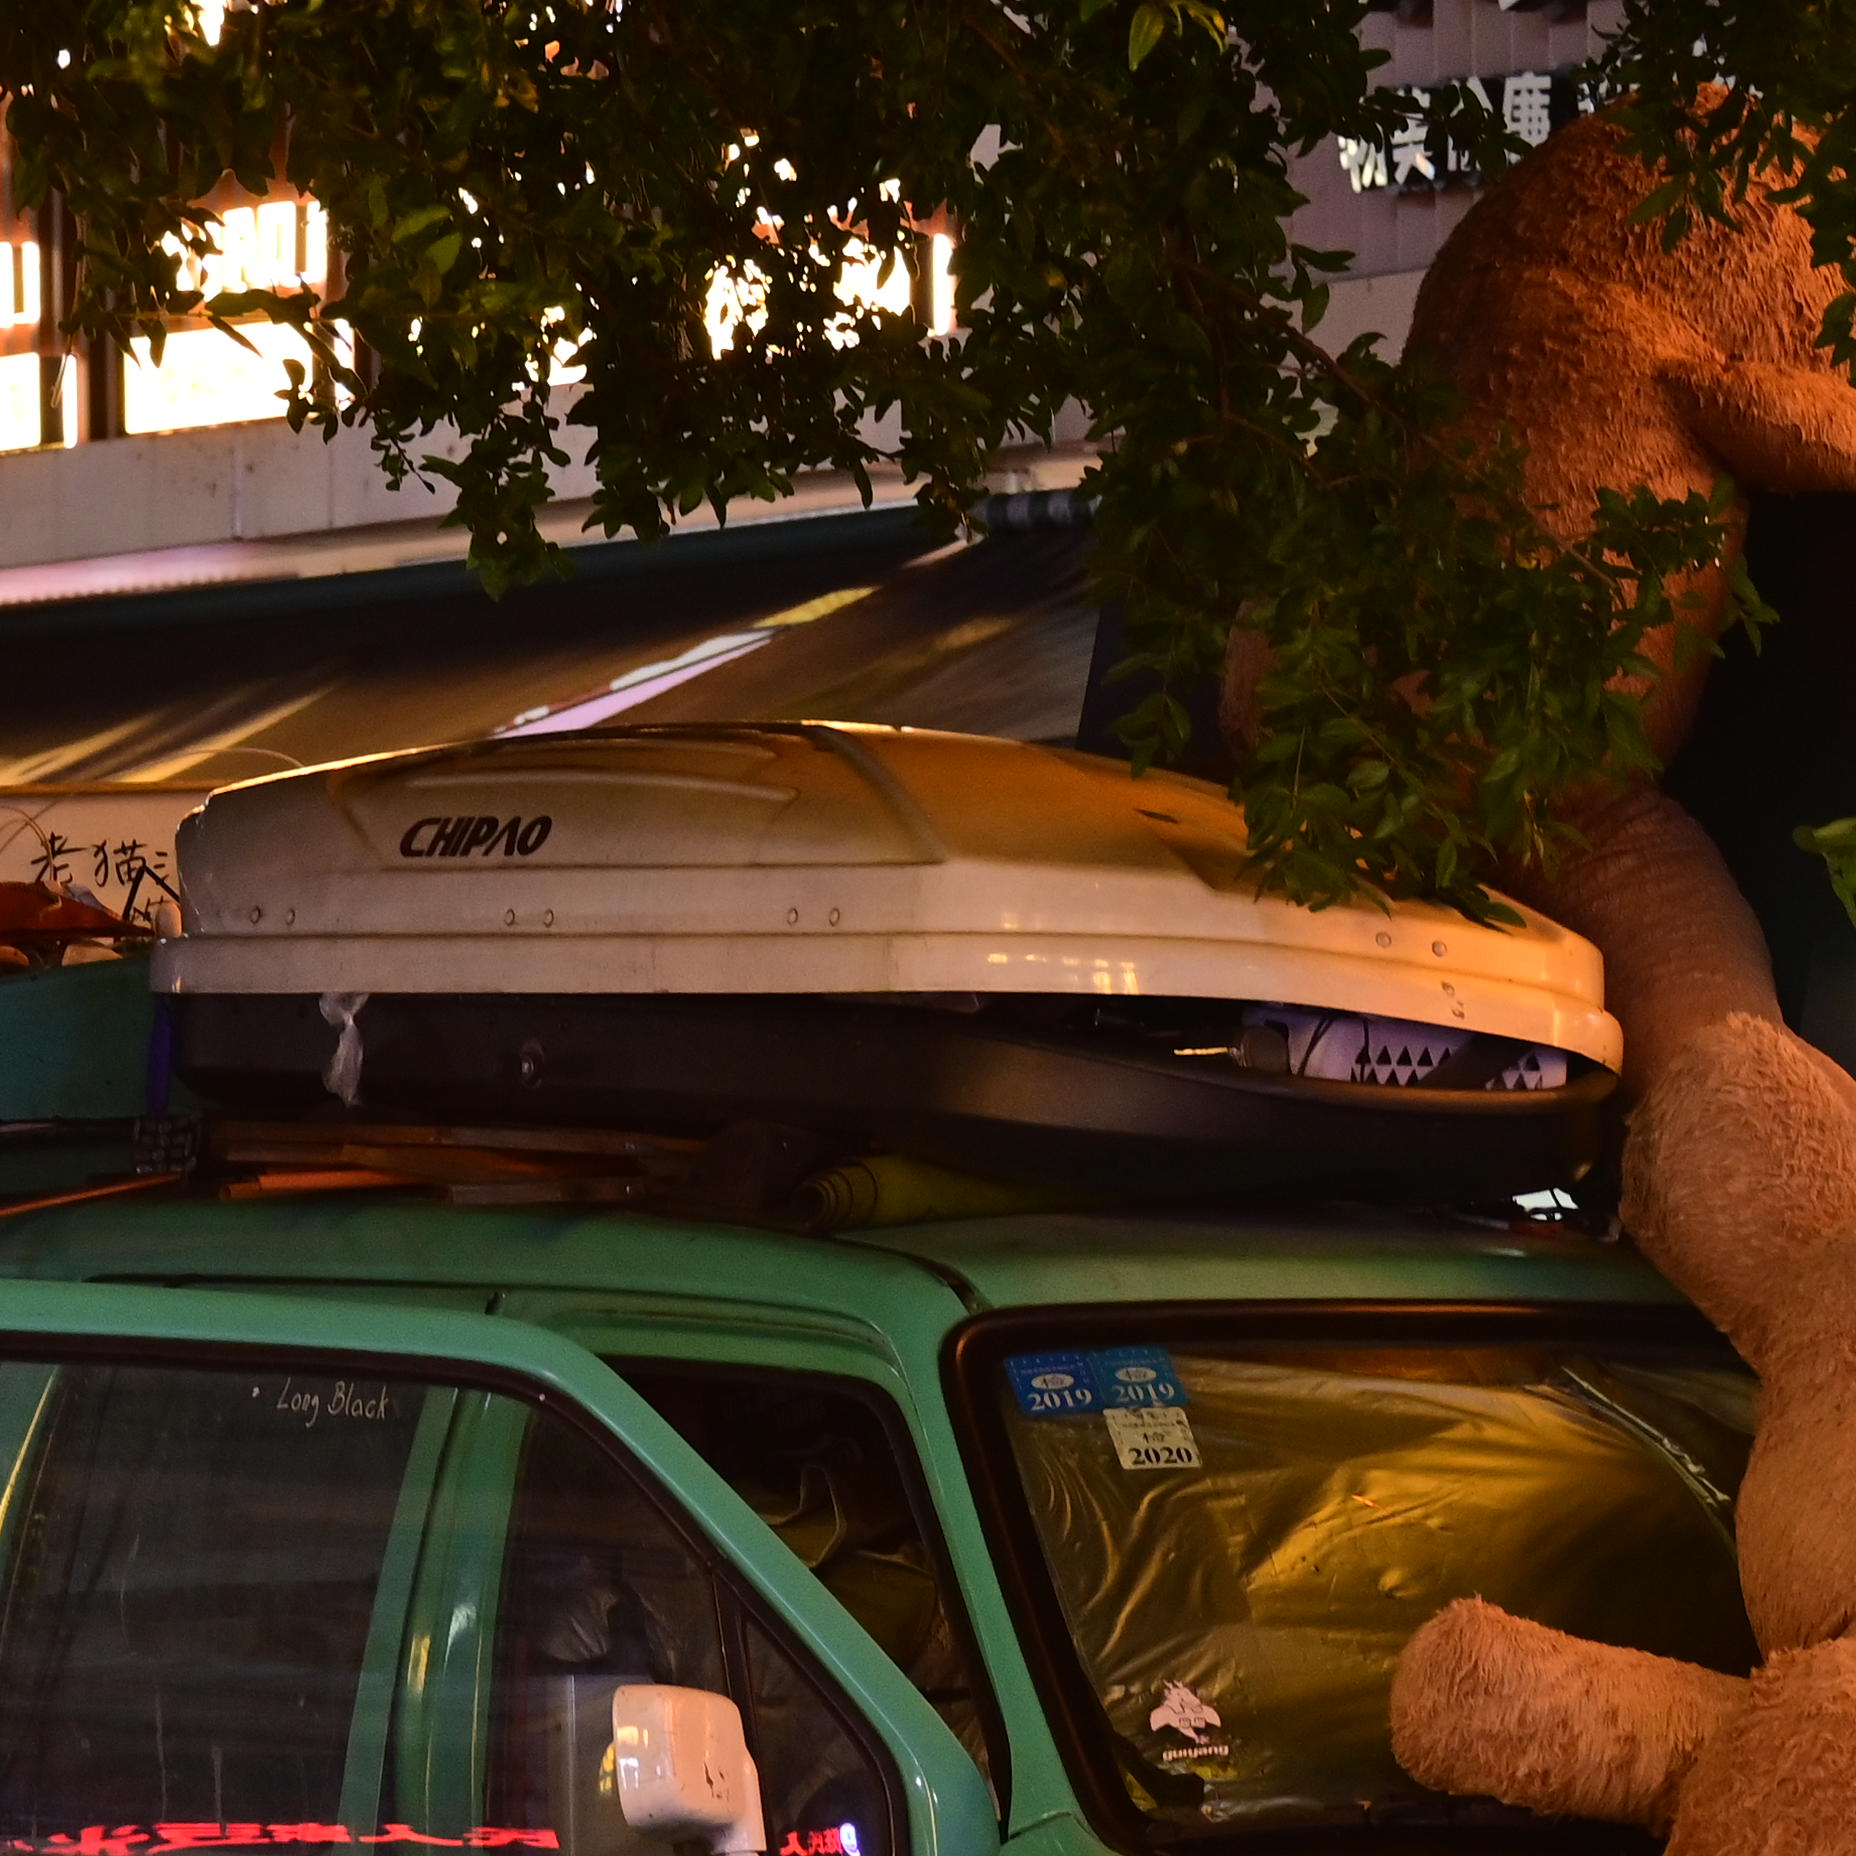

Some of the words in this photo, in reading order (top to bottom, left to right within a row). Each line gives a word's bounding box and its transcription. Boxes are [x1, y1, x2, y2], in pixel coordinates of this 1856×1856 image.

[400, 815, 553, 858] CHIPAO
[276, 1376, 320, 1428] Long
[328, 1380, 389, 1420] Black
[1027, 1388, 1093, 1412] 2019
[1111, 1382, 1175, 1403] 2019
[1128, 1446, 1193, 1466] 2020
[1162, 1745, 1229, 1761] guiyang
